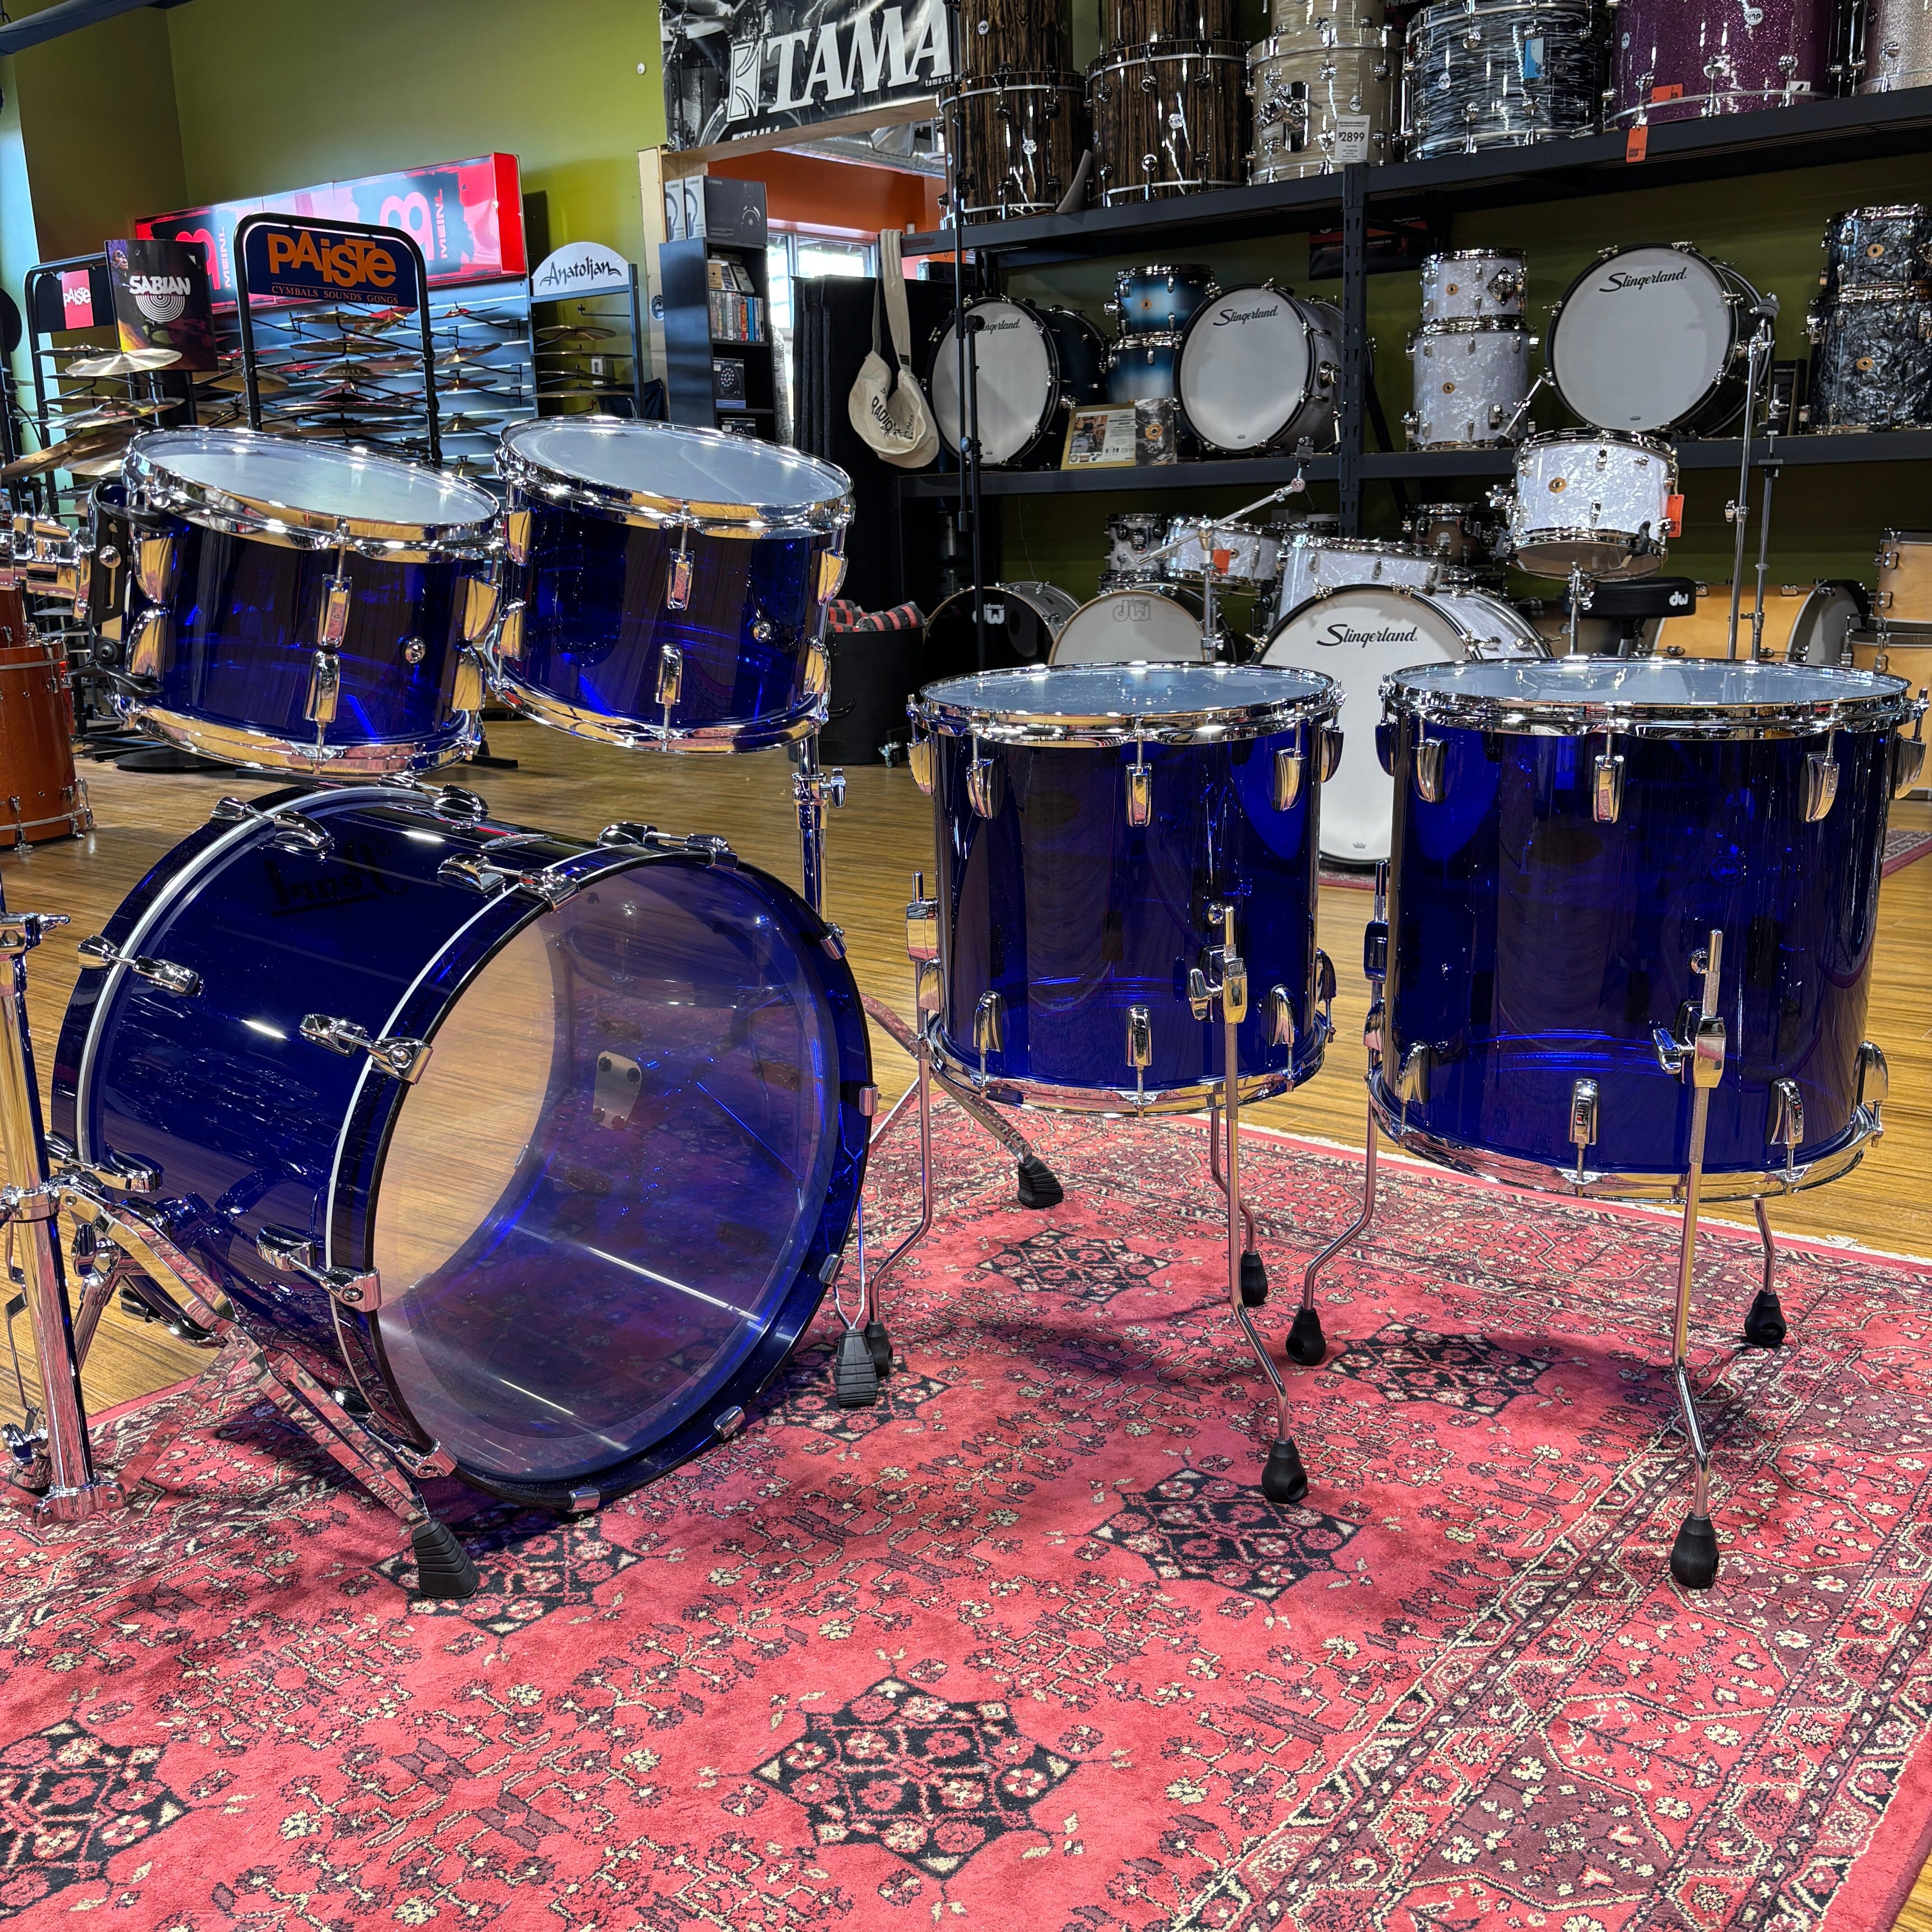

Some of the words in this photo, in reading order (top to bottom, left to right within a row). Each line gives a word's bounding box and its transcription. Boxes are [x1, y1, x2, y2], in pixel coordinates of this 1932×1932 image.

[767, 0, 952, 114] TAMA
[1338, 132, 1365, 142] $2899
[435, 189, 447, 259] MEINL
[219, 226, 231, 289] MEINL
[540, 256, 622, 286] Anatolian
[1599, 267, 1687, 292] Slingerland
[129, 275, 191, 295] SABIAN
[271, 286, 318, 298] CYMBALS
[324, 290, 362, 302] SOUNDS
[366, 294, 398, 304] GONGS
[1213, 305, 1278, 326] Slingerland
[1669, 591, 1688, 606] dw
[1316, 621, 1417, 649] Slingerland
